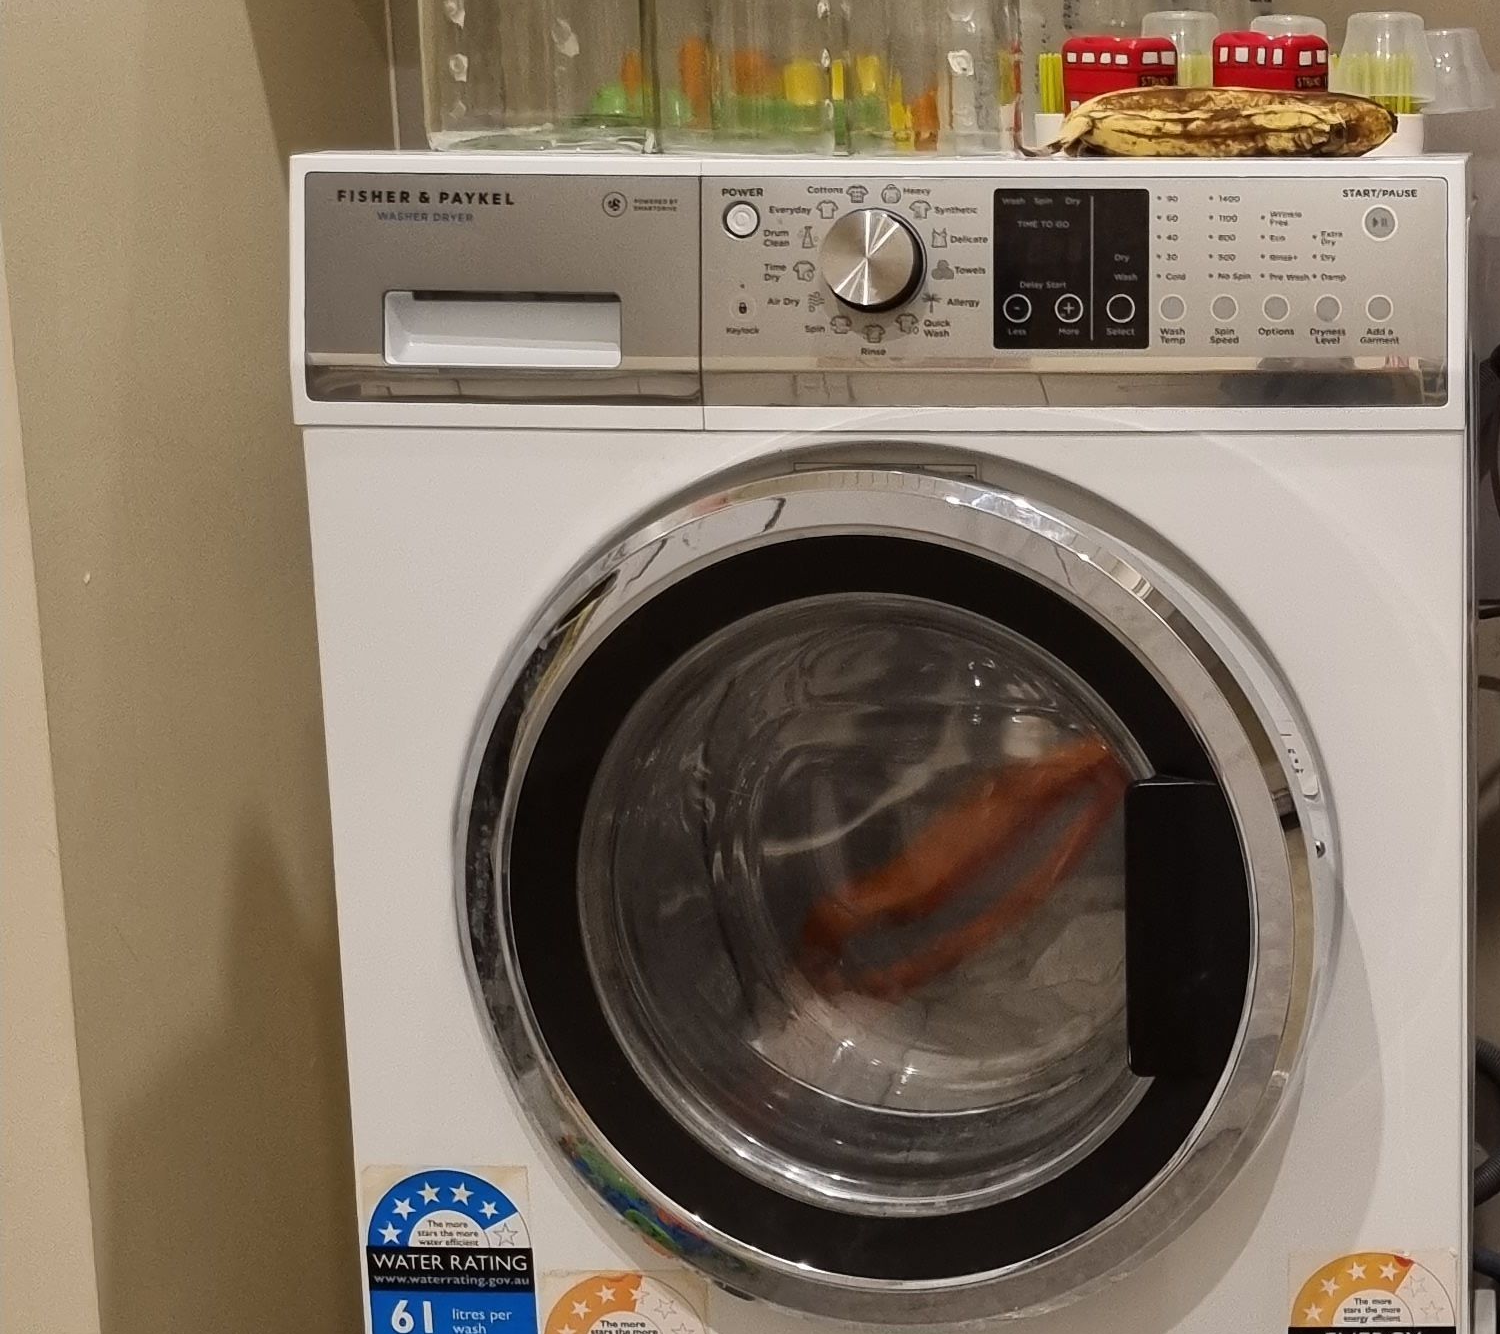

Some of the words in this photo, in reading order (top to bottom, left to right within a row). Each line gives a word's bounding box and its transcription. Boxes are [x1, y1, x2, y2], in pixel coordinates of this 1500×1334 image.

[721, 187, 764, 197] POWER
[807, 186, 844, 195] Cottons
[1342, 189, 1418, 198] START/PAUSE
[337, 190, 411, 204] FISHER
[419, 192, 431, 205] &
[439, 192, 515, 205] PAYKEL
[1065, 197, 1081, 207] Dry
[769, 205, 812, 216] Everyday
[934, 205, 978, 215] Synthetic
[377, 212, 429, 222] WASHER
[433, 213, 473, 223] DRYER
[764, 229, 789, 237] Drum
[764, 238, 790, 247] Clean
[950, 235, 989, 244] Delicate
[1114, 253, 1130, 263] Dry
[1320, 254, 1336, 263] Dry
[764, 263, 787, 272] Time
[954, 266, 987, 275] Towels
[764, 272, 781, 283] Dry
[1166, 272, 1186, 281] Cold
[1218, 273, 1230, 281] No
[1232, 273, 1251, 282] Spin
[1020, 281, 1043, 290] Delay
[1046, 281, 1067, 289] Start
[767, 298, 780, 306] Air
[783, 298, 800, 308] Dry
[947, 298, 980, 309] Allergy
[924, 319, 951, 329] Quick
[805, 324, 826, 334] Spin
[924, 329, 950, 338] Wash
[1008, 328, 1027, 336] Less
[1059, 328, 1080, 336] More
[1106, 328, 1135, 336] Select
[1160, 328, 1186, 336] Wash
[1214, 328, 1235, 337] Spin
[1258, 328, 1295, 337] Options
[1310, 328, 1346, 337] Dryness
[1366, 328, 1386, 336] Add
[1160, 337, 1186, 346] Temp
[1210, 336, 1240, 345] Speed
[1315, 336, 1340, 344] Level
[1360, 336, 1400, 345] Garment
[860, 347, 886, 356] Rinse
[428, 1220, 443, 1228] The
[446, 1239, 479, 1247] efficient
[372, 1254, 444, 1270] WATER
[450, 1255, 527, 1271] RATING
[374, 1274, 529, 1287] www.waterrating.gov.au
[391, 1300, 434, 1334] 61
[452, 1308, 485, 1320] litres
[490, 1311, 512, 1323] per
[452, 1323, 486, 1334] wash
[600, 1320, 618, 1328] The
